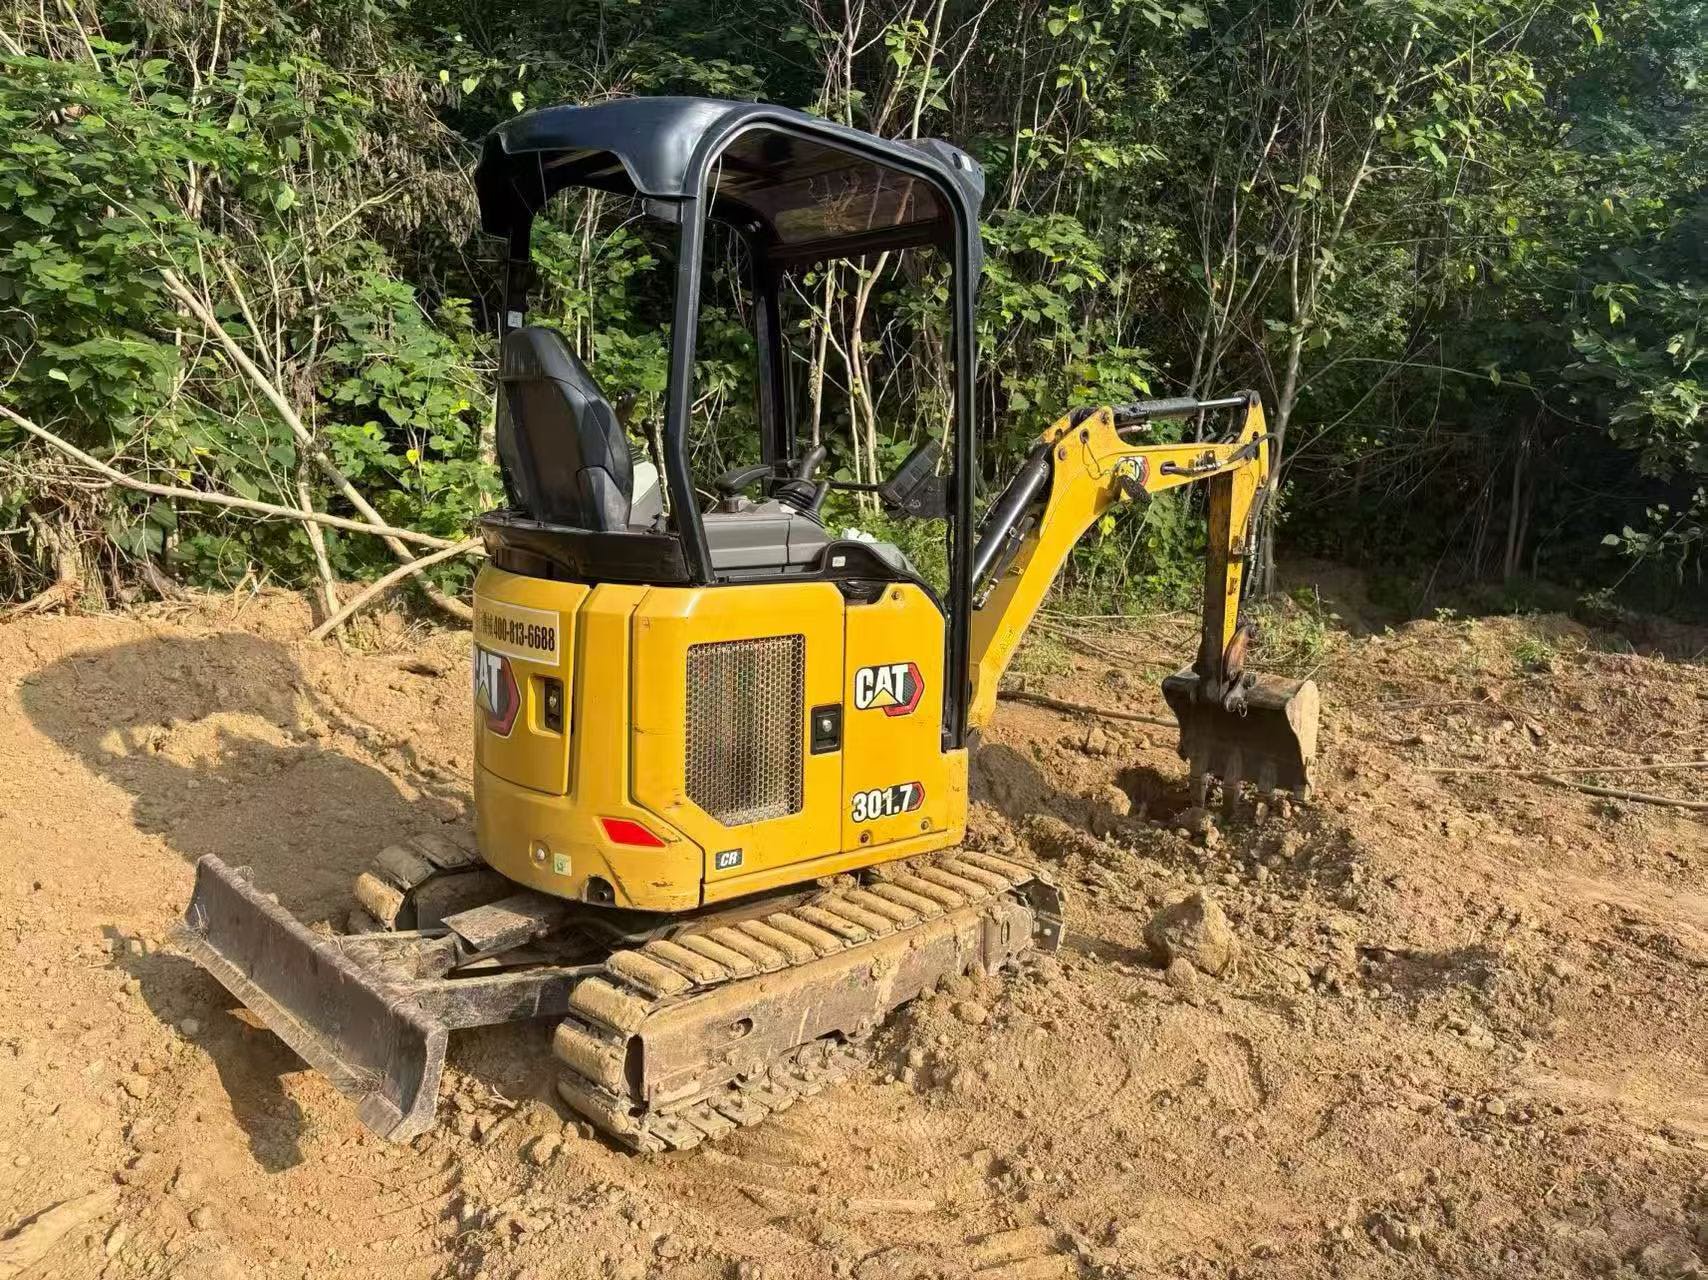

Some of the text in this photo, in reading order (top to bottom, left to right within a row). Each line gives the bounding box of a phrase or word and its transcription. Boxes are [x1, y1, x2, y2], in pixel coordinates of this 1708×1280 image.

[493, 615, 555, 651] 400-813-6688
[856, 664, 909, 709] CAT
[852, 784, 913, 822] 301.7
[720, 851, 738, 867] CR
